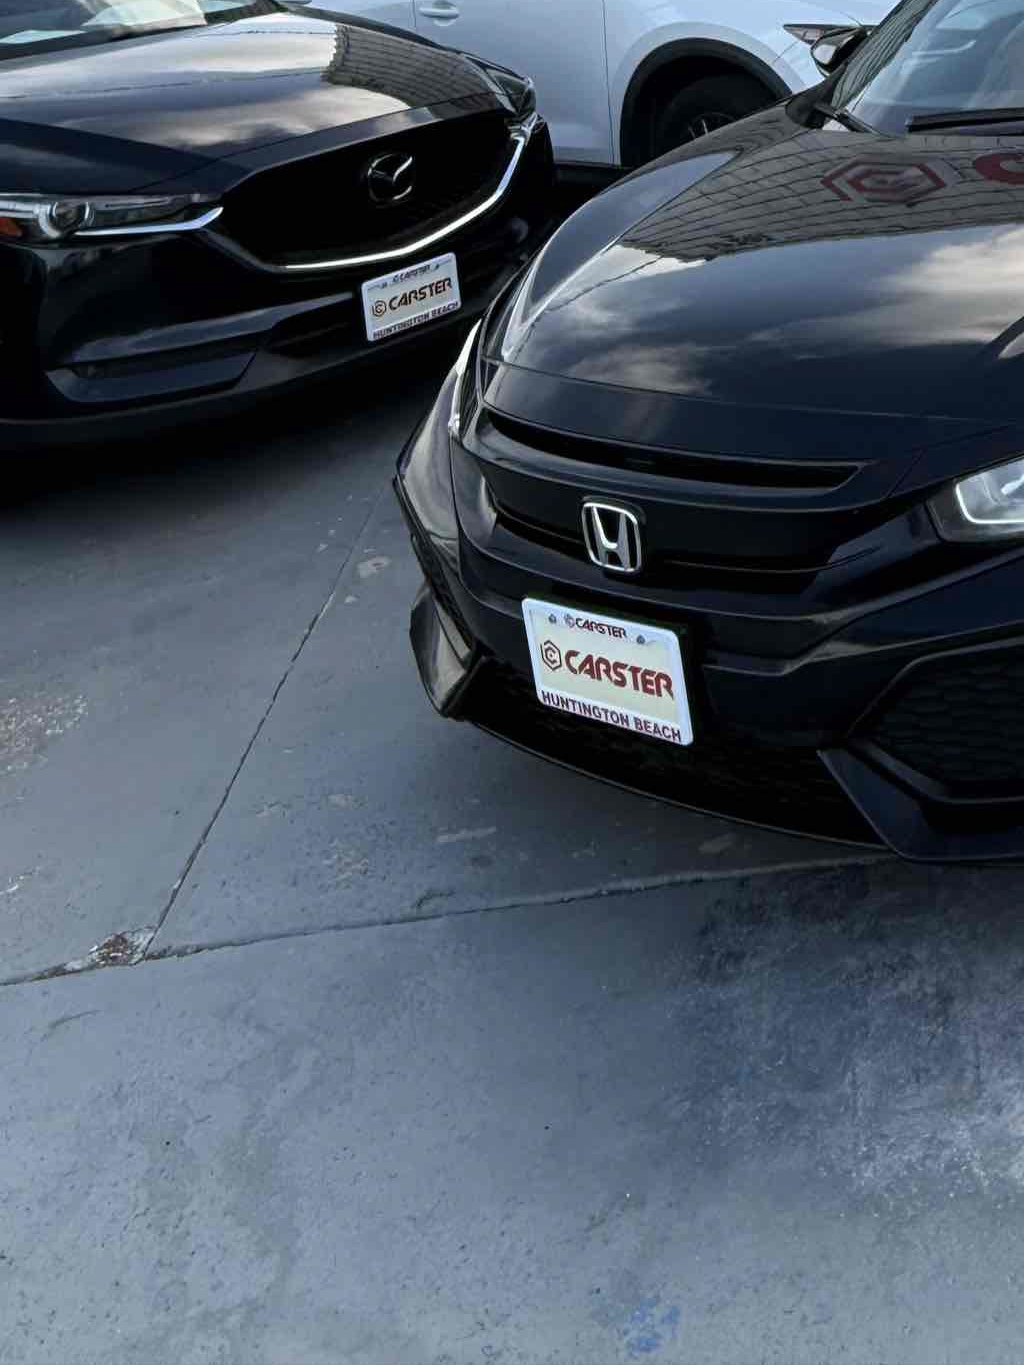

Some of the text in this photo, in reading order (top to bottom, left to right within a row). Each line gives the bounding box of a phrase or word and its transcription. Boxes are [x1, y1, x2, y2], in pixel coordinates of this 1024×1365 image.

[388, 277, 453, 311] CARSTER
[575, 617, 627, 638] CARSTER
[564, 649, 675, 701] CARSTER
[541, 689, 682, 743] HUNTINGTON BEACH
